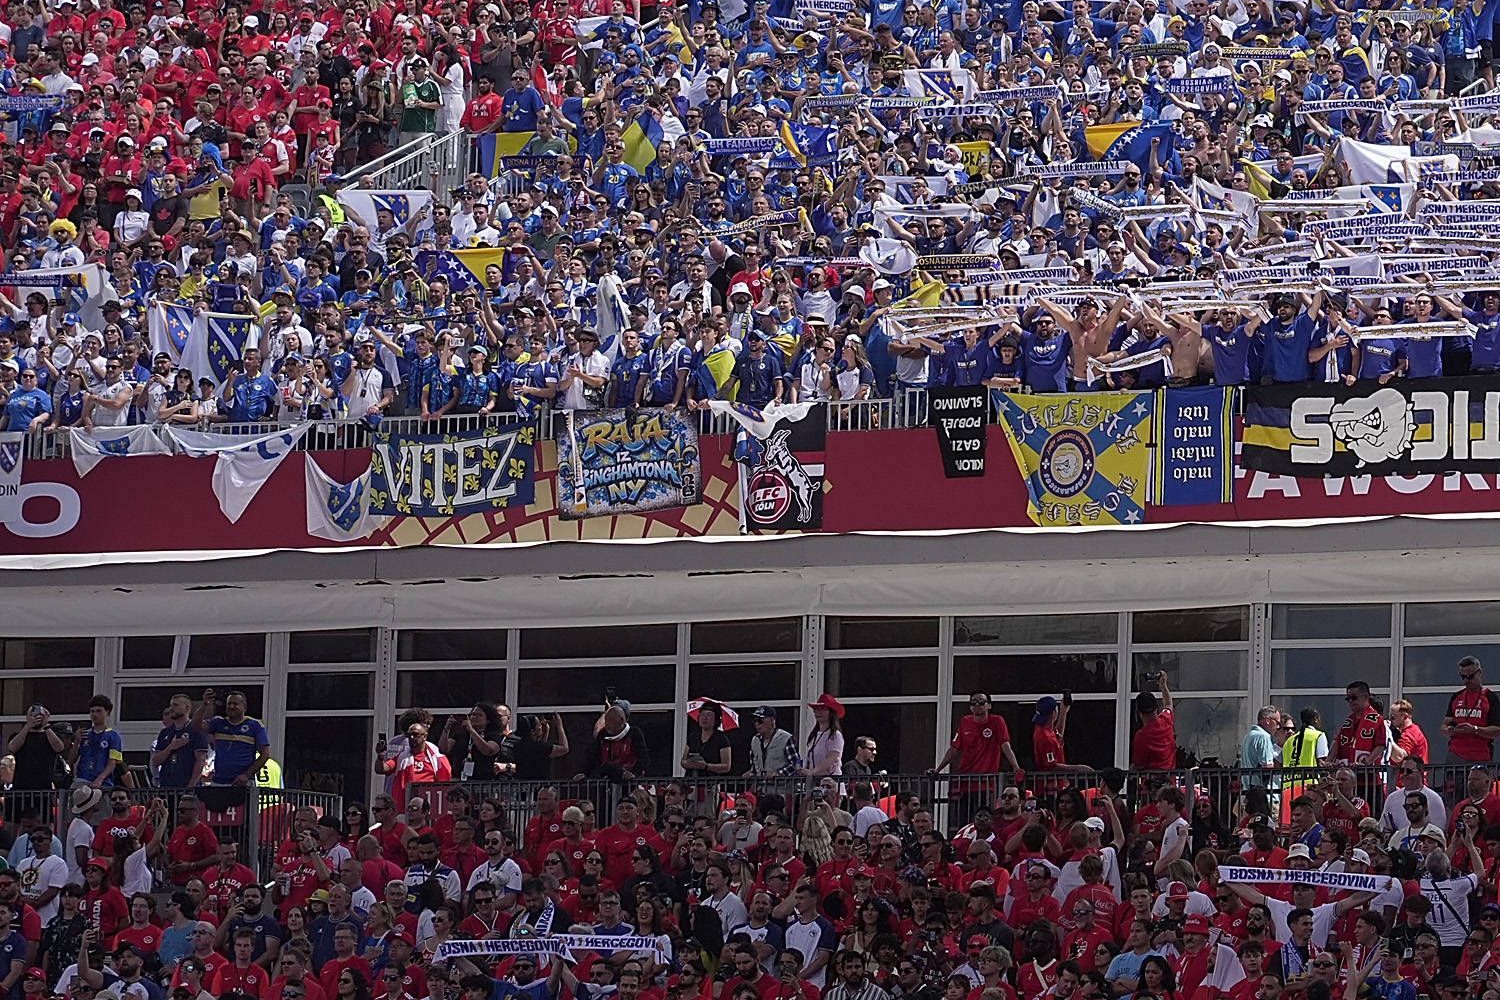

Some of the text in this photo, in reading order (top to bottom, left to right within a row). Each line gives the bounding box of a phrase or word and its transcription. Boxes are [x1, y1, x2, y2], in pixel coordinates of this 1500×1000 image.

[923, 106, 984, 117] GAZIJE
[710, 140, 724, 148] BH
[1030, 160, 1120, 175] BOSNA HERCEGOVINA
[609, 174, 619, 184] 20
[970, 266, 1073, 285] BOSNA HERCEGOVINA
[583, 414, 671, 458] RAJA
[616, 452, 632, 462] IZ
[374, 432, 519, 507] VITEZ
[610, 480, 645, 501] NY
[754, 501, 775, 513] KÖLN
[1229, 868, 1377, 890] BOSNA HERCEGOVINA
[1432, 904, 1445, 924] 11
